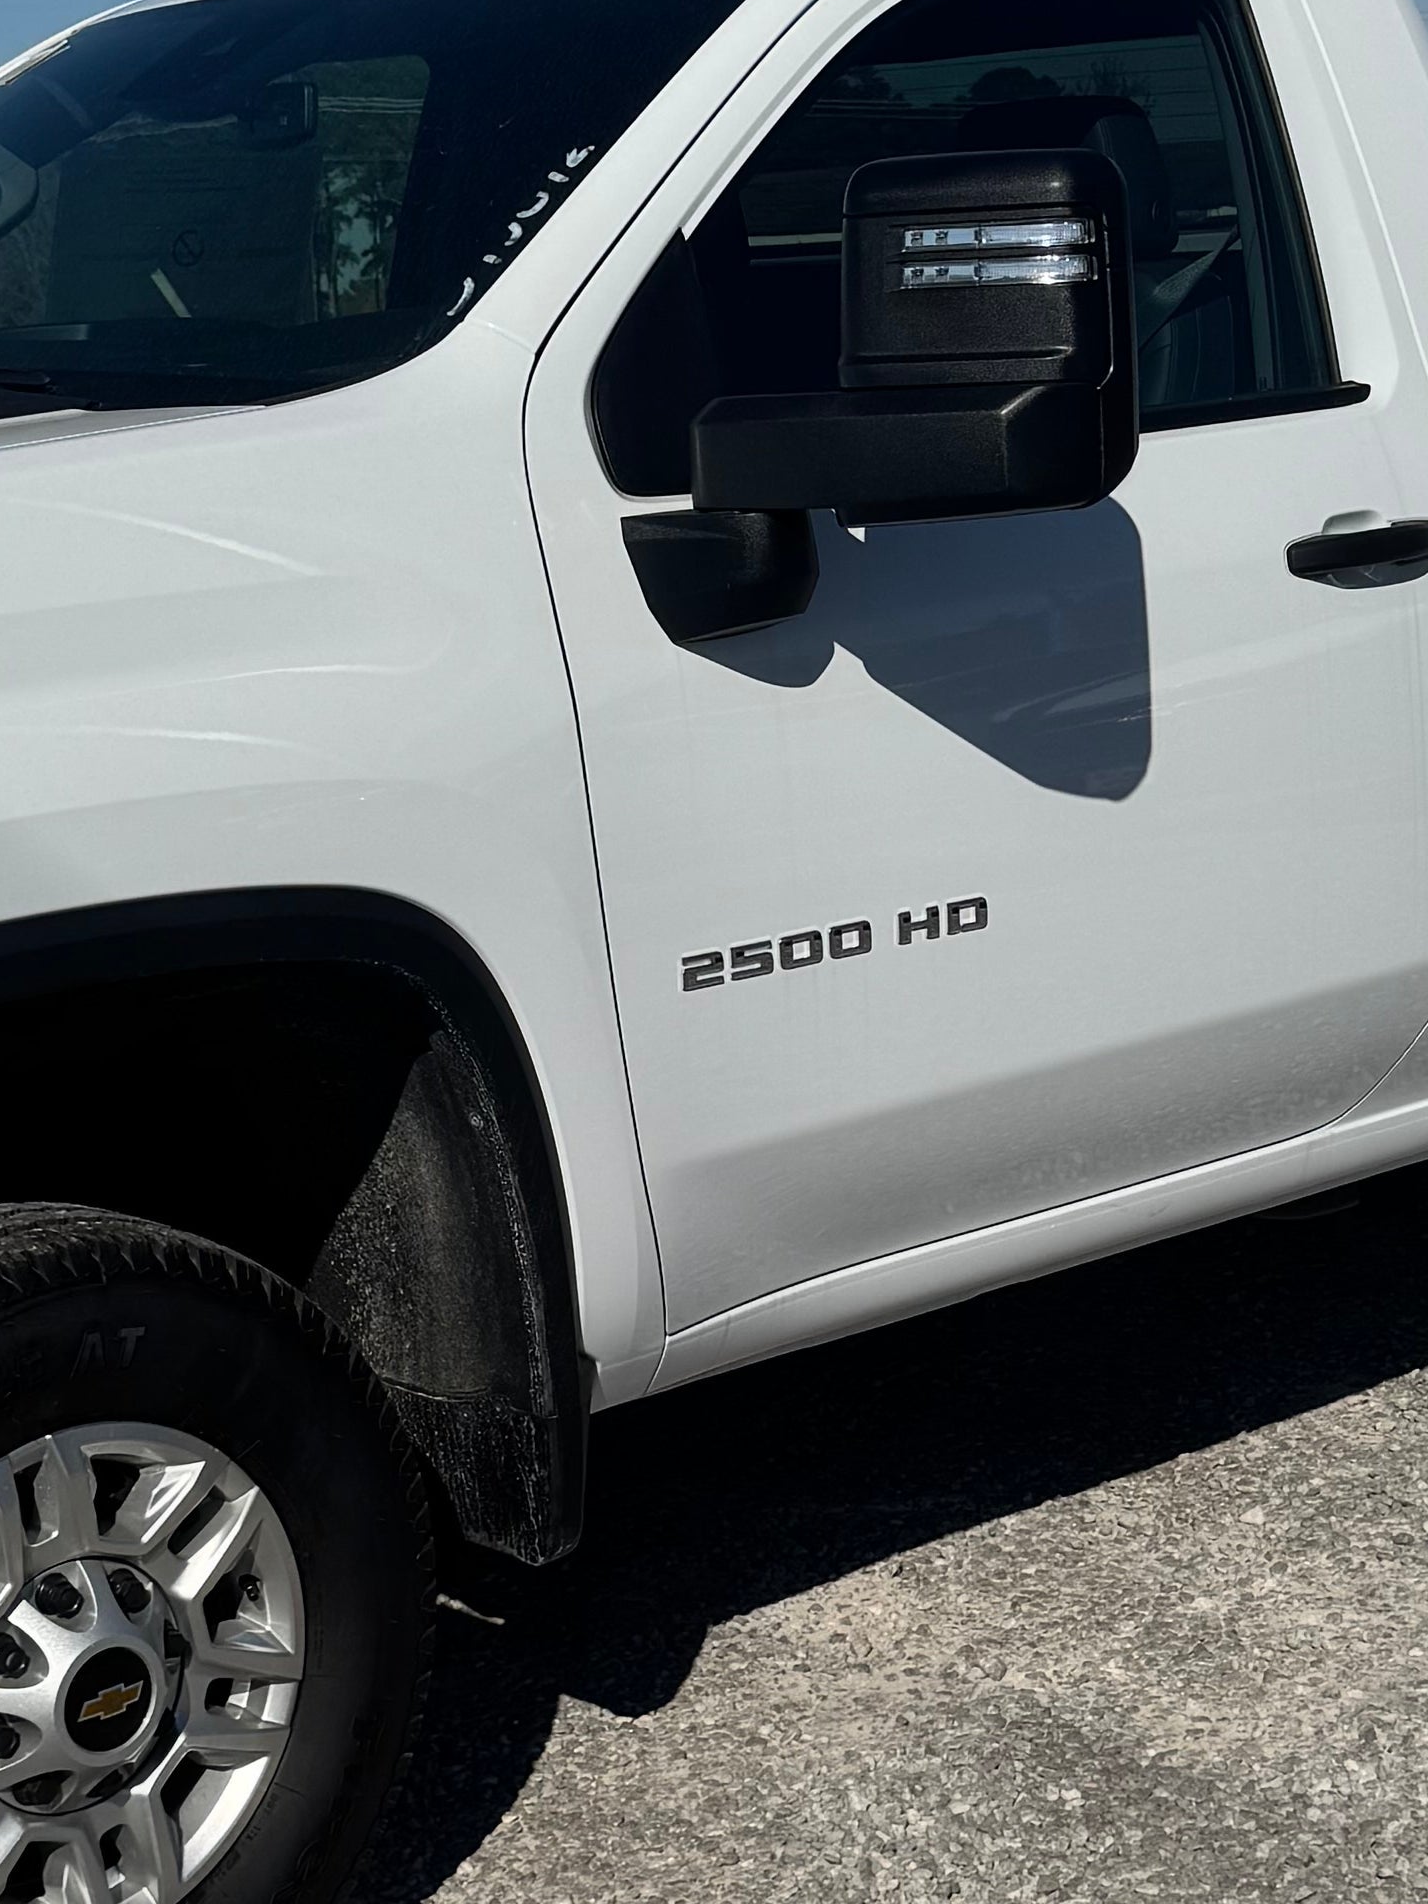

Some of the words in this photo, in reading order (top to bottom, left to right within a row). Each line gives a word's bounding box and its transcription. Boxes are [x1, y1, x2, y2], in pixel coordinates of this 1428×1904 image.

[681, 919, 873, 993] 2500
[897, 895, 989, 946] HD
[69, 1323, 149, 1381] AT
